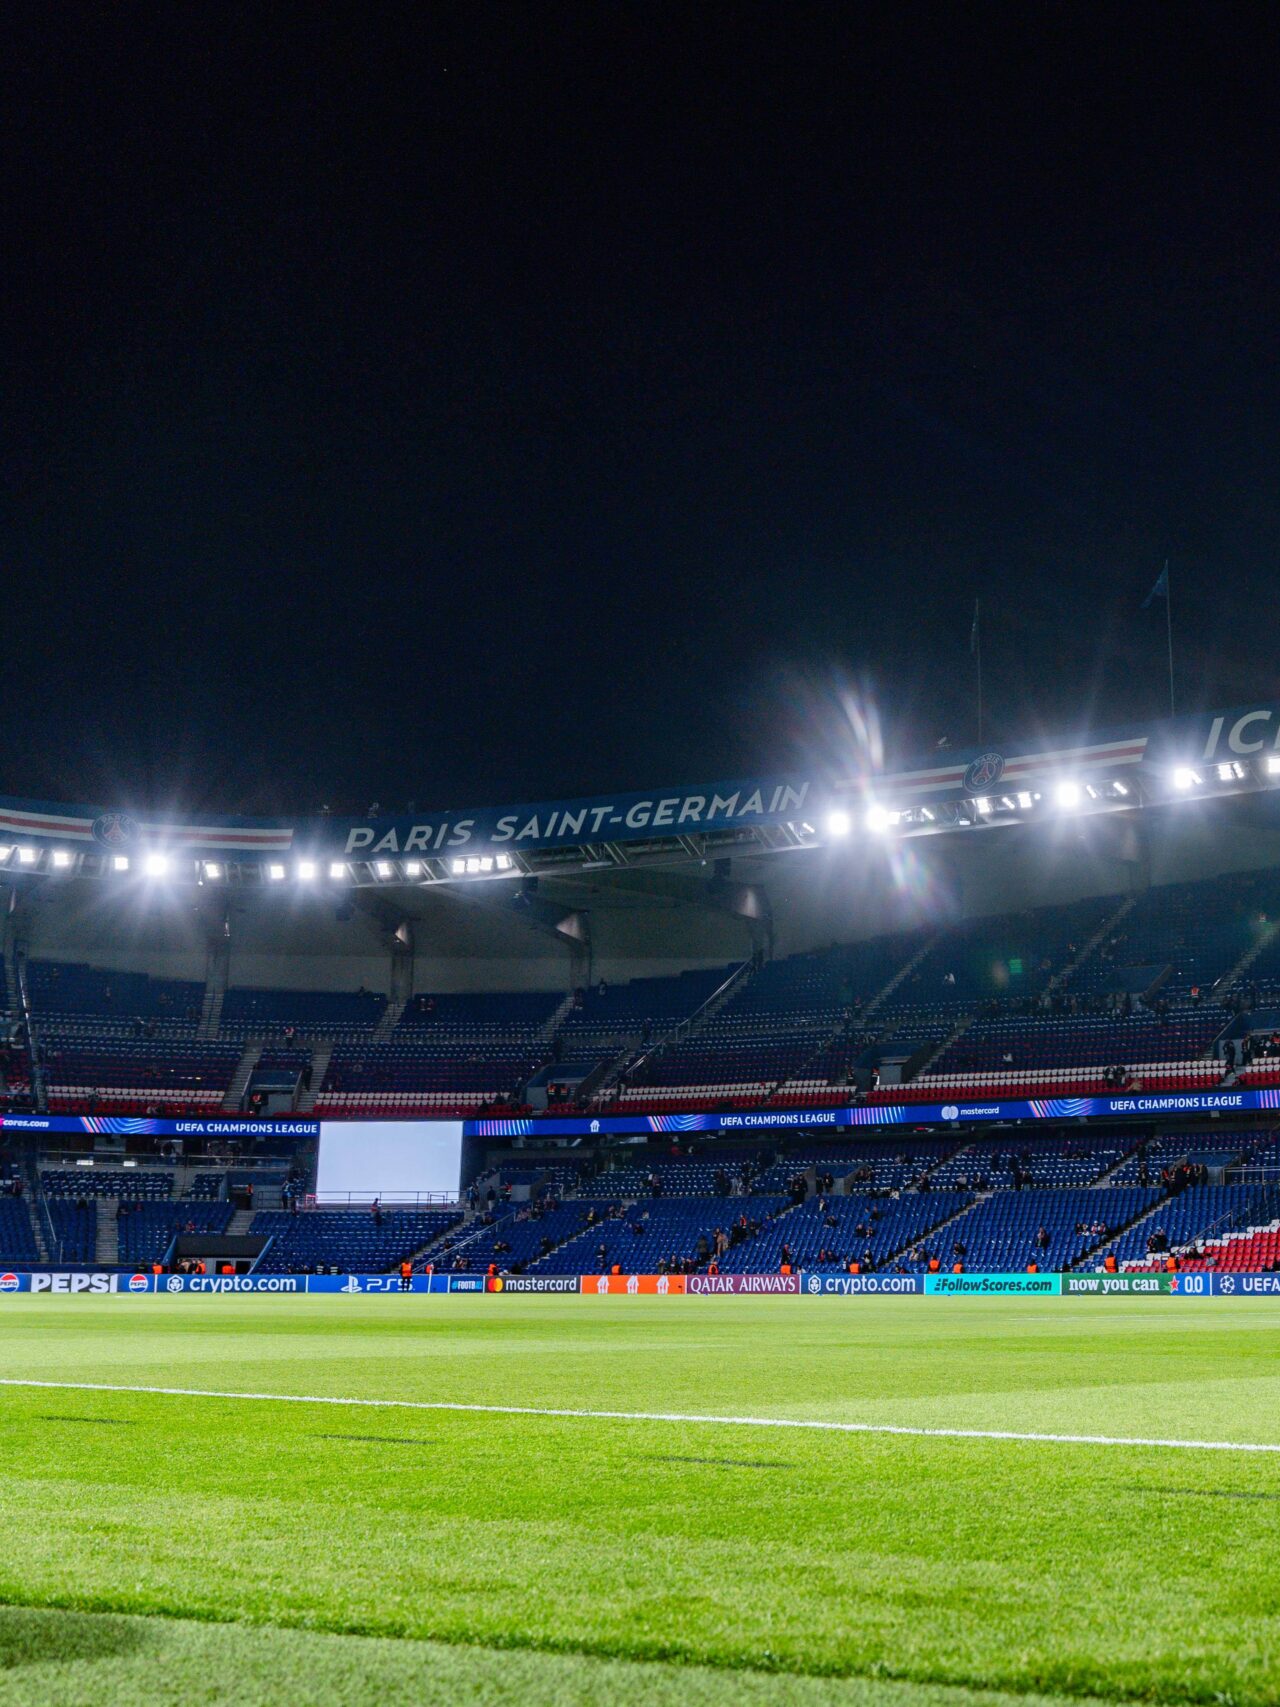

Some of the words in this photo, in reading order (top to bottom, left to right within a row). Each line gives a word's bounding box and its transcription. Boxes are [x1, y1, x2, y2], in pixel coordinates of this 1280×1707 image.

[344, 820, 475, 853] PARIS
[490, 782, 810, 842] SAINT-GERMAIN
[960, 1107, 1000, 1115] mastercard
[1110, 1100, 1136, 1111] UEFA
[1138, 1096, 1200, 1110] CHAMPIONS
[1201, 1095, 1243, 1107] LEAGUE
[175, 1121, 205, 1132] UEFA
[207, 1122, 273, 1133] CHAMPIONS
[275, 1124, 318, 1134] LEAGUE
[720, 1117, 743, 1127] UEFA
[744, 1115, 799, 1126] CHAMPIONS
[800, 1113, 836, 1124] LEAGUE
[31, 1274, 119, 1293] PEPSI
[189, 1275, 296, 1293] crypto.com
[505, 1277, 577, 1291] mastercard
[690, 1276, 735, 1293] QATAR
[740, 1276, 796, 1292] AIRWAYS
[825, 1276, 915, 1293] crypto.com
[1068, 1278, 1098, 1291] now
[1101, 1279, 1128, 1294] you
[1132, 1279, 1160, 1291] can
